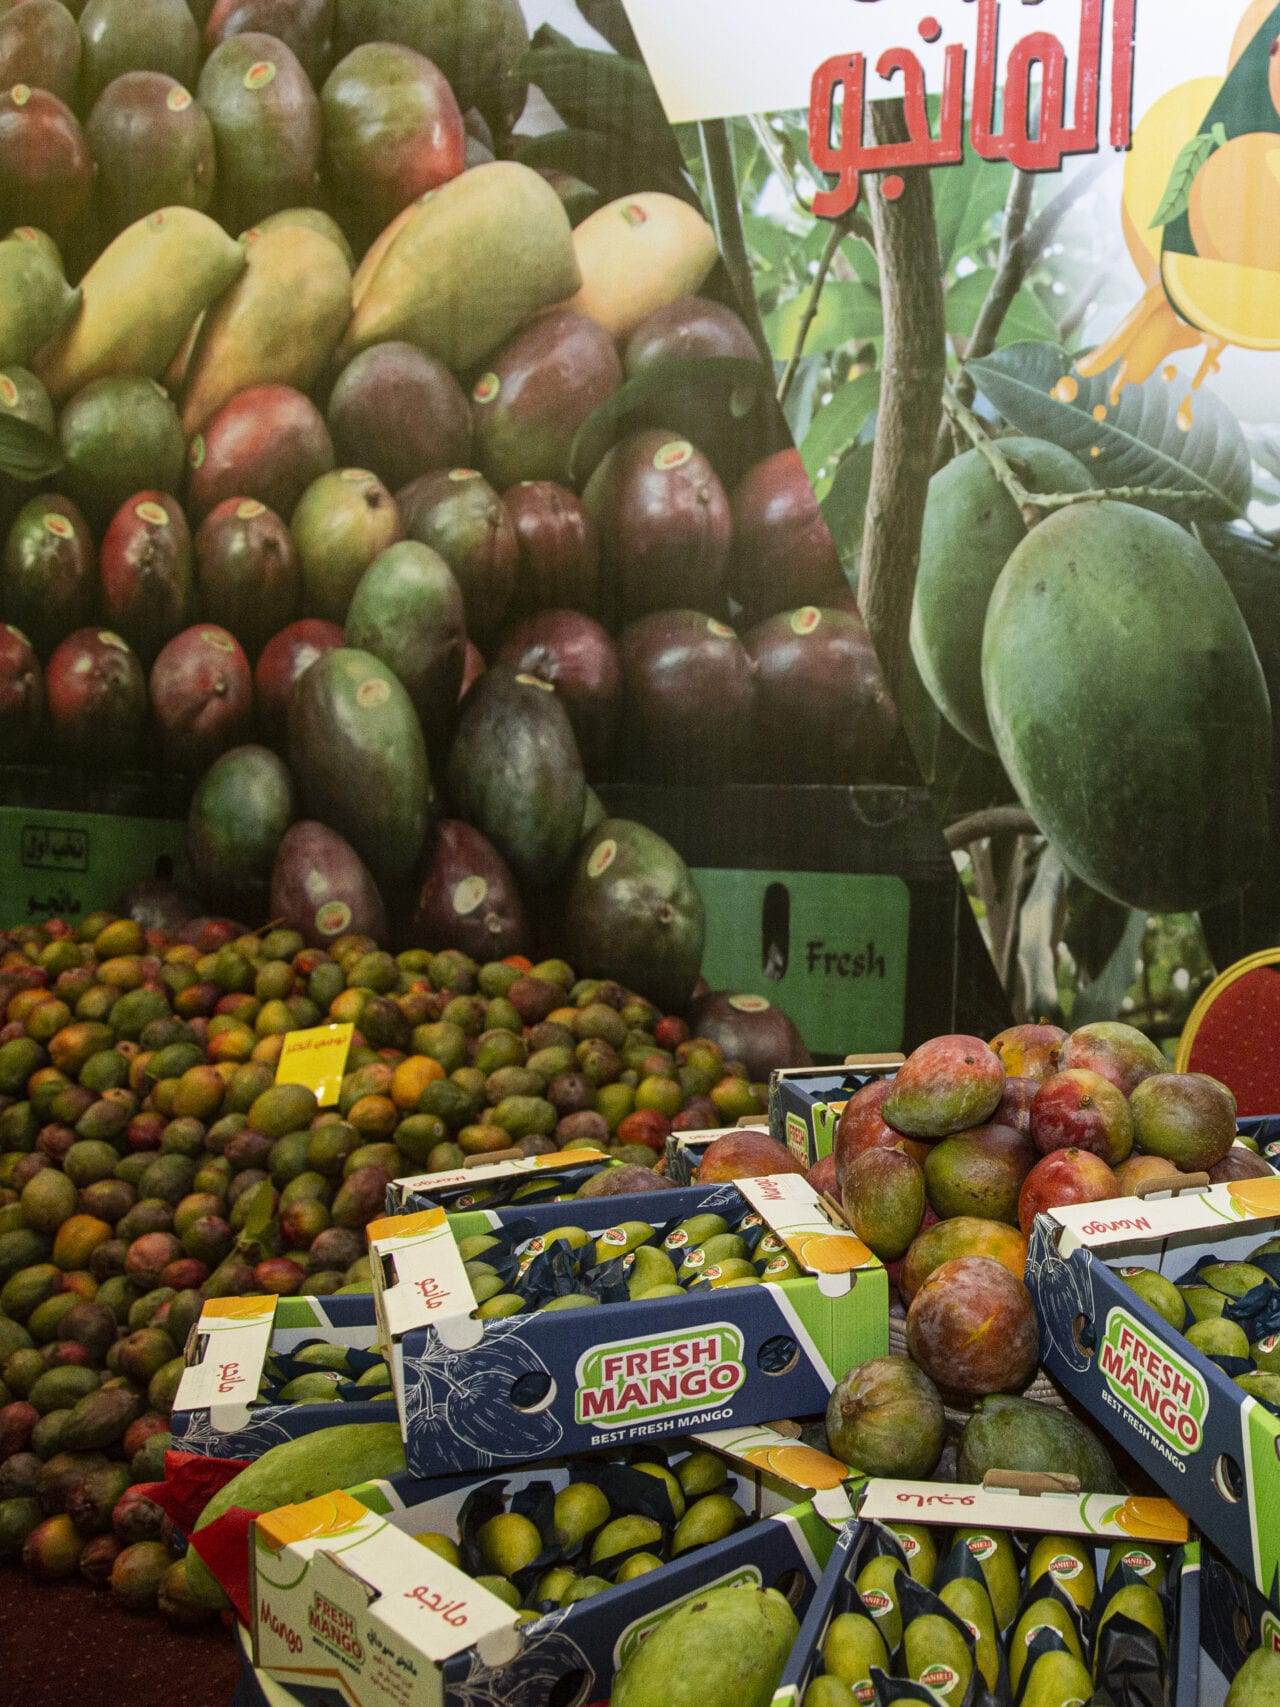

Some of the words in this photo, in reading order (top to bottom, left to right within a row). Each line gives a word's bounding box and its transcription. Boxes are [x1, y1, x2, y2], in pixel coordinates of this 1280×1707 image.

[806, 940, 886, 979] Fresh
[1081, 1216, 1152, 1236] Mango
[604, 1338, 717, 1382] FRESH
[1119, 1327, 1192, 1406] FRESH
[582, 1364, 740, 1418] MANGO
[1102, 1344, 1199, 1446] MANGO
[591, 1430, 627, 1446] BEST
[629, 1420, 675, 1438] FRESH
[677, 1408, 734, 1428] MANGO
[1101, 1389, 1123, 1414] BEST
[1122, 1409, 1151, 1441] FRESH
[1151, 1435, 1186, 1473] MANGO
[968, 1539, 993, 1553] ANIELI
[316, 1597, 354, 1634] FRESH
[403, 1586, 468, 1627] مانجو
[309, 1610, 363, 1660] MANGO
